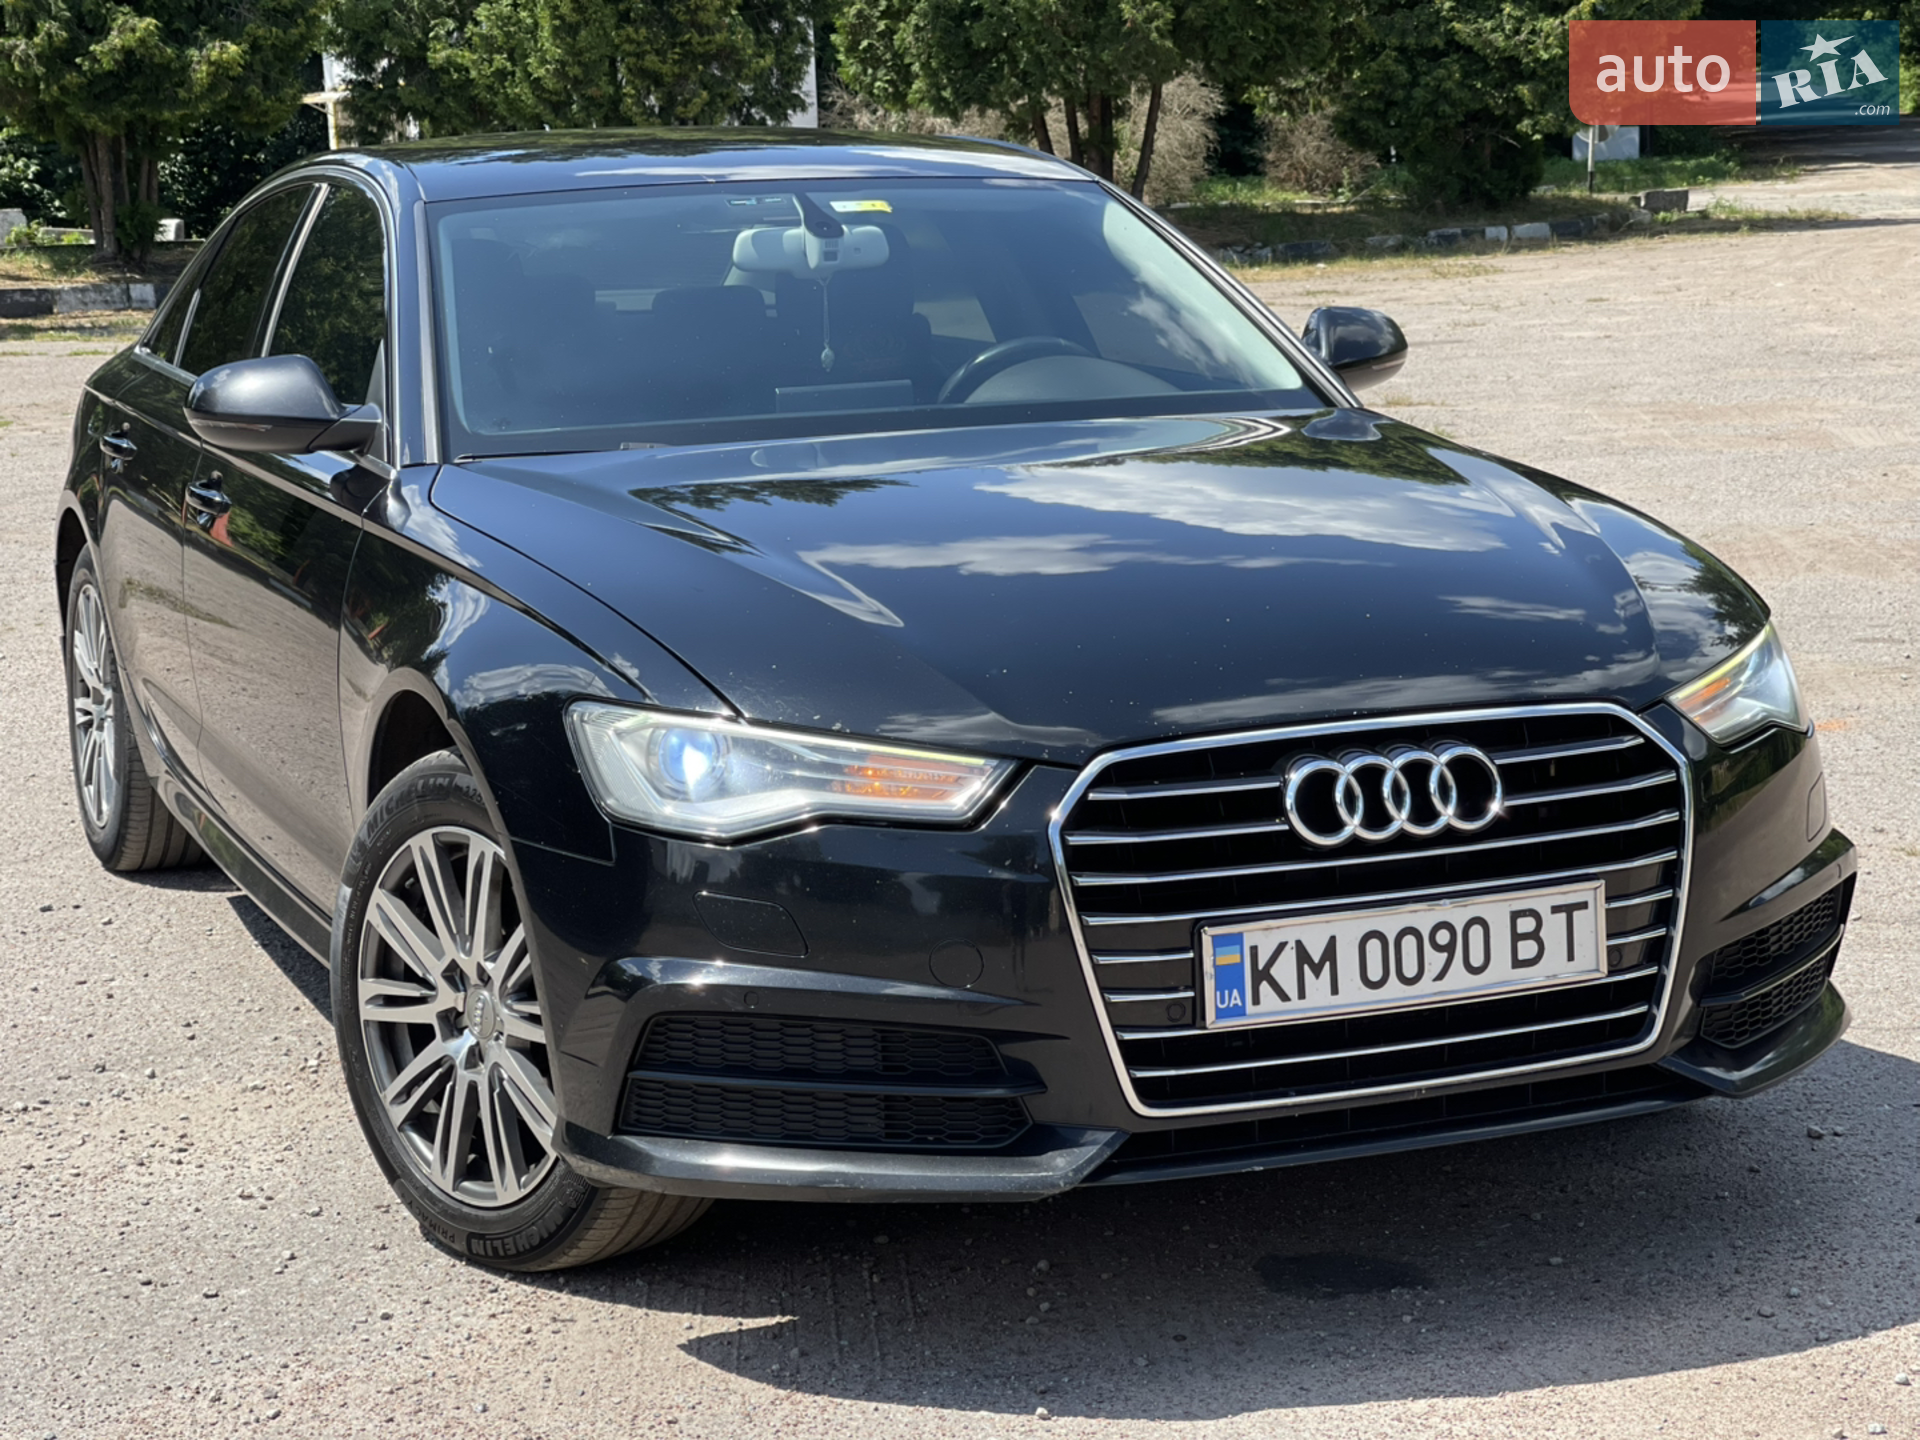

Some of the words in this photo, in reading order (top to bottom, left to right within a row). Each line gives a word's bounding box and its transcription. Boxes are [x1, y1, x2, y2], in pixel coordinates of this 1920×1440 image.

[1249, 934, 1340, 1006] KM
[1357, 915, 1492, 991] 0090
[1509, 901, 1589, 970] BT
[1215, 988, 1243, 1009] UA
[470, 1203, 564, 1257] MICHELIN
